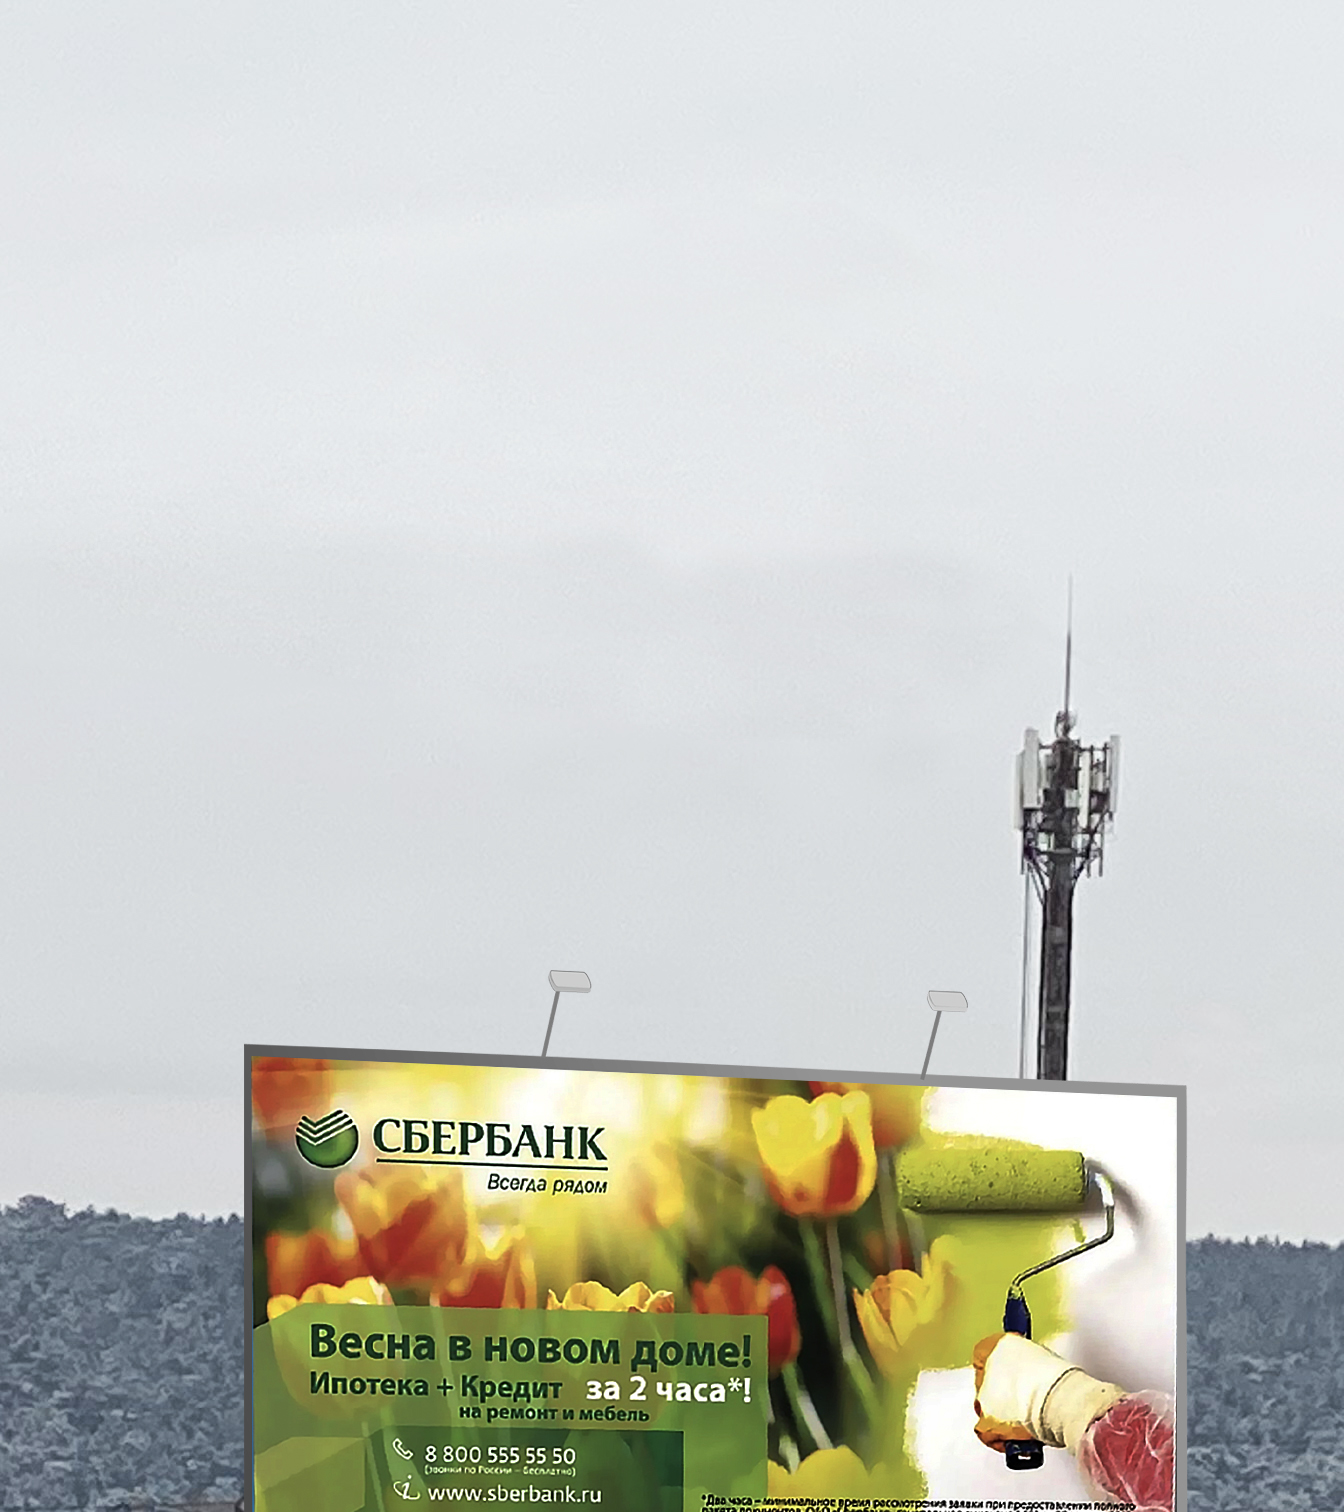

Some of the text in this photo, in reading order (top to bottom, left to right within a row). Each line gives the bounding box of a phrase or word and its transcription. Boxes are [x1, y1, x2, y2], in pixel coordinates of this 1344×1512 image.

[373, 1118, 608, 1161] СБЕРБАНК
[487, 1173, 608, 1195] Всегда рядом
[310, 1323, 752, 1373] Весна в новом доме!
[310, 1371, 429, 1396] Ипотека
[436, 1378, 454, 1397] +
[461, 1374, 564, 1403] Кредит
[586, 1380, 621, 1400] за
[629, 1375, 647, 1401] 2
[459, 1405, 650, 1423] на ремонт и мебель
[424, 1446, 576, 1464] 8 800 555 55 50
[428, 1484, 602, 1503] www.sberbank.ru
